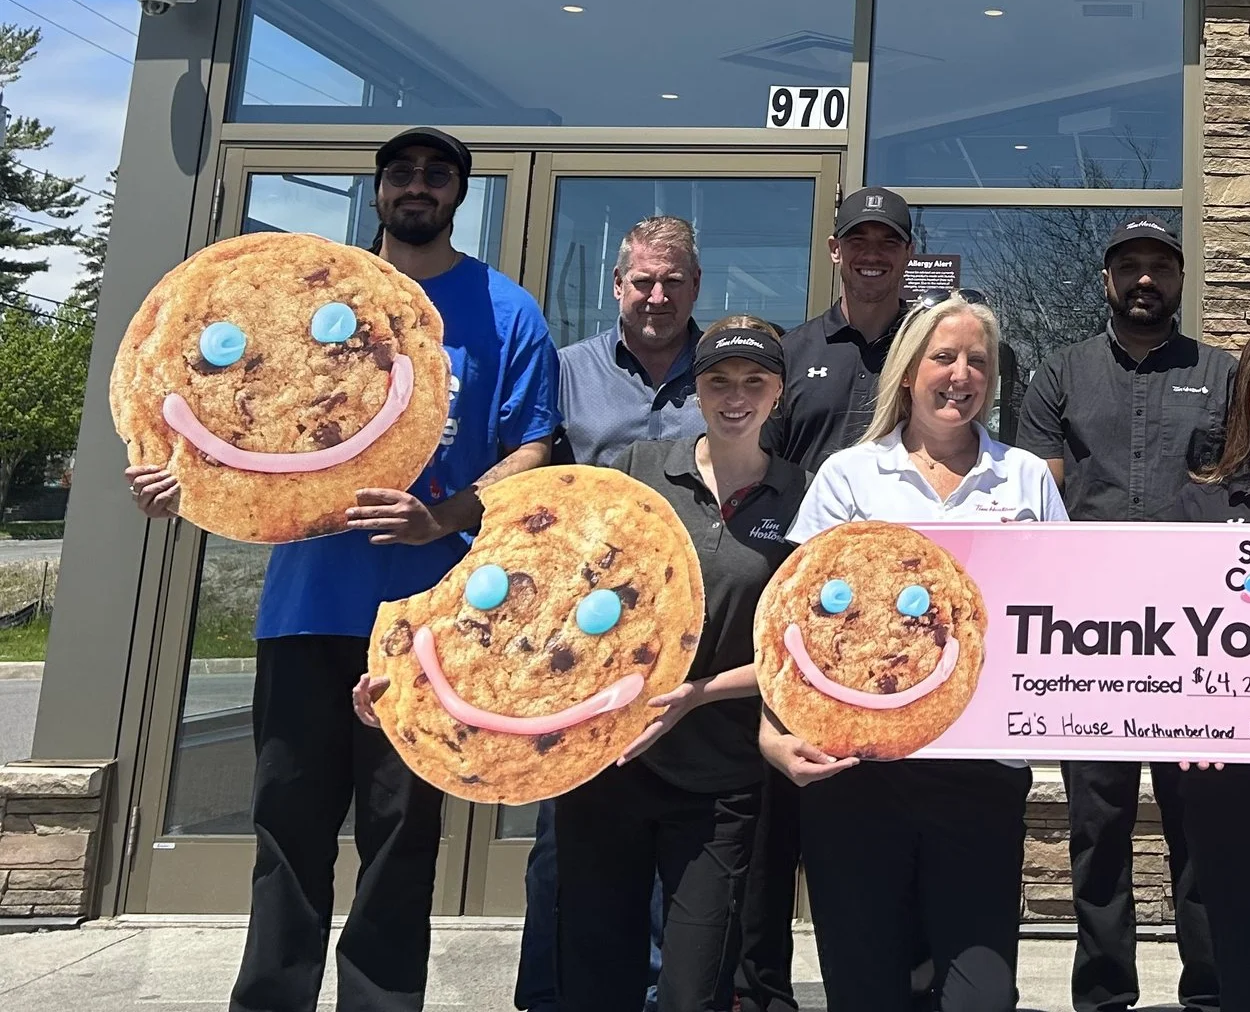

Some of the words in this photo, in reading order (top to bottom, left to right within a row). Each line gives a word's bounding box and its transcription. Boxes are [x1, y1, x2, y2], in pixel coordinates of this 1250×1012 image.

[771, 87, 845, 128] 970
[907, 259, 934, 269] Allergy
[933, 260, 953, 268] Alert
[760, 518, 781, 531] Tim
[1006, 605, 1176, 657] Thank
[1011, 673, 1096, 696] Together
[1098, 678, 1124, 693] we
[1127, 675, 1183, 694] raised
[1061, 713, 1114, 736] House
[1123, 718, 1235, 739] Northumberland
